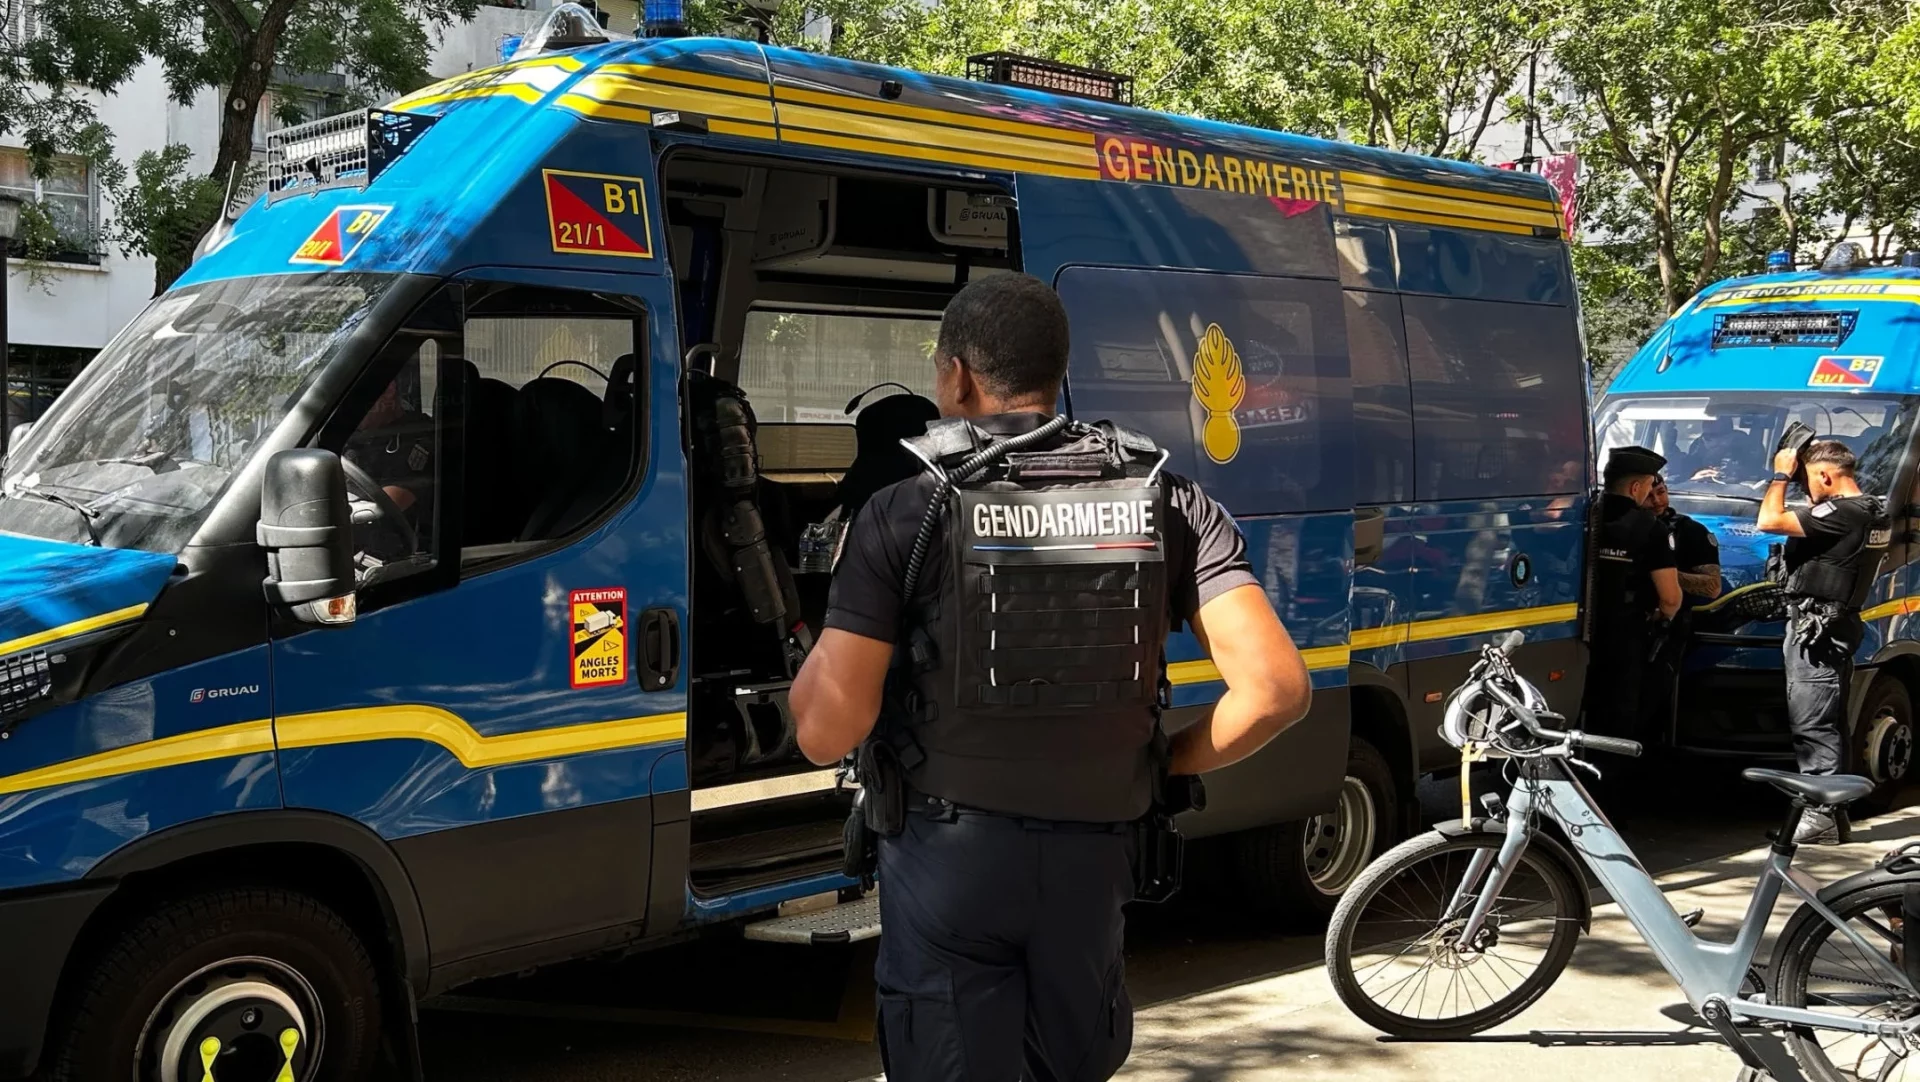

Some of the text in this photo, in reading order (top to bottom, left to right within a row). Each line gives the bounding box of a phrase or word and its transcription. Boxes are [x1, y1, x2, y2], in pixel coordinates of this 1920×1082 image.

[1103, 138, 1339, 205] GENDARMERIE
[603, 183, 639, 215] B1
[345, 210, 381, 234] B1
[559, 222, 605, 246] 21/1
[1731, 284, 1883, 299] GENDARMERIE
[1849, 358, 1877, 372] B2
[973, 500, 1155, 538] GENDARMERIE
[574, 591, 624, 602] ATTENTION
[580, 656, 619, 669] ANGLES
[582, 667, 617, 679] MORTS
[208, 685, 259, 698] GRUAU
